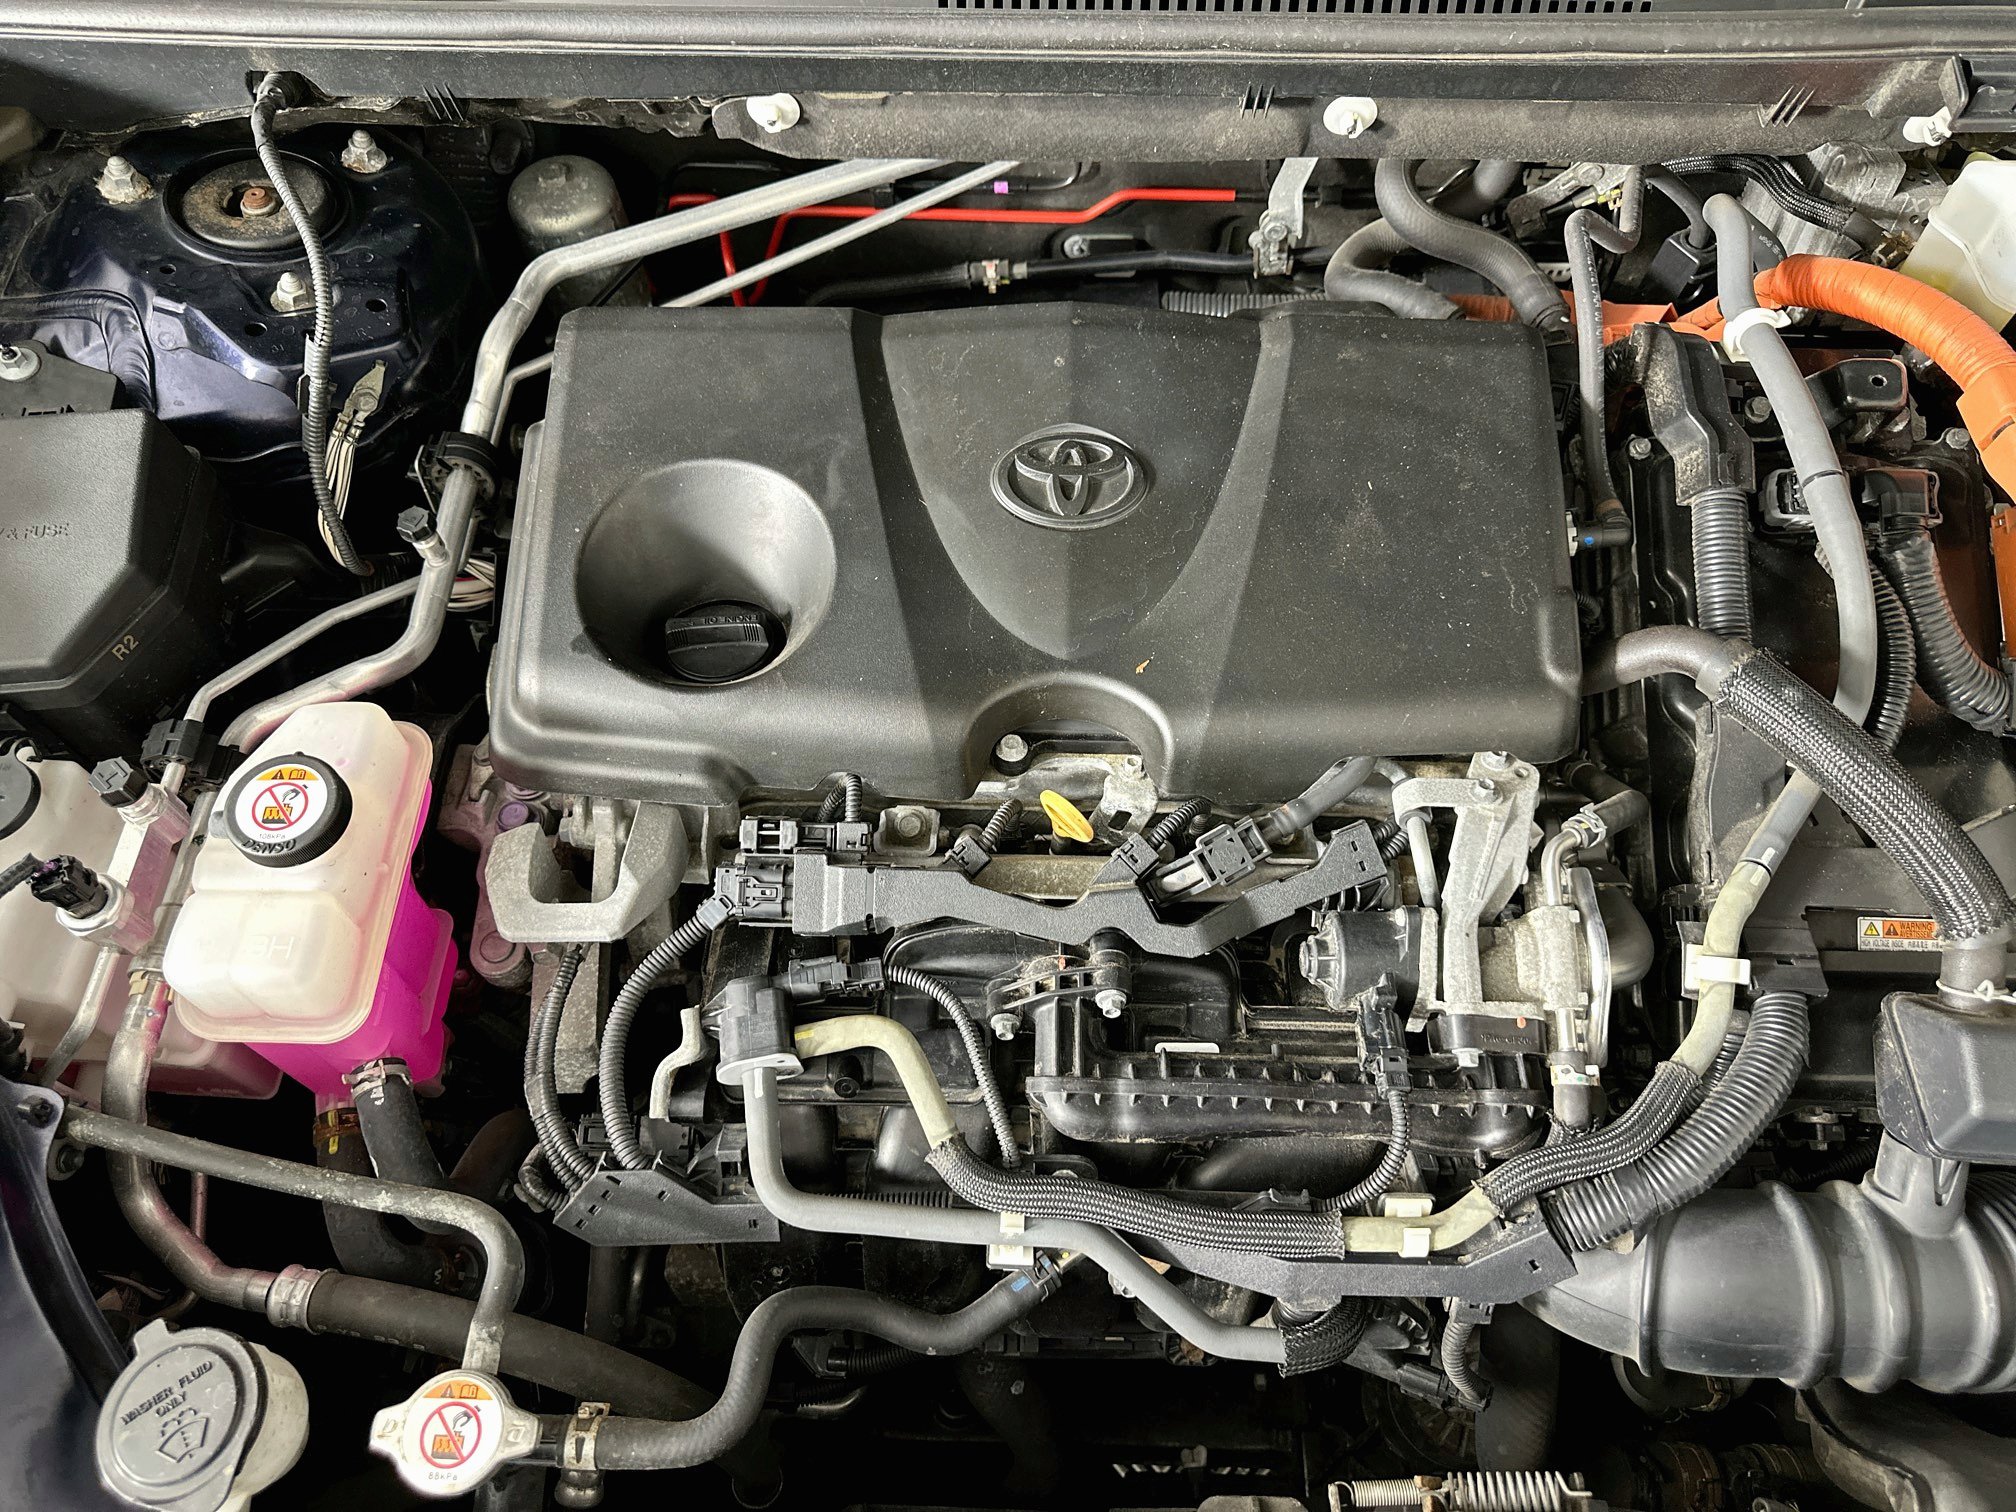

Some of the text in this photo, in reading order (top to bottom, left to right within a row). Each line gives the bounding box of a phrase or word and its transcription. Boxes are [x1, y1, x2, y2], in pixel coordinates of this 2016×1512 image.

[112, 634, 139, 661] R2
[242, 839, 297, 855] DENSO
[1900, 922, 1932, 931] WARNING
[121, 1361, 213, 1425] WASHER FLUID
[155, 1391, 187, 1417] ONLY
[428, 1472, 458, 1481] 88kPa
